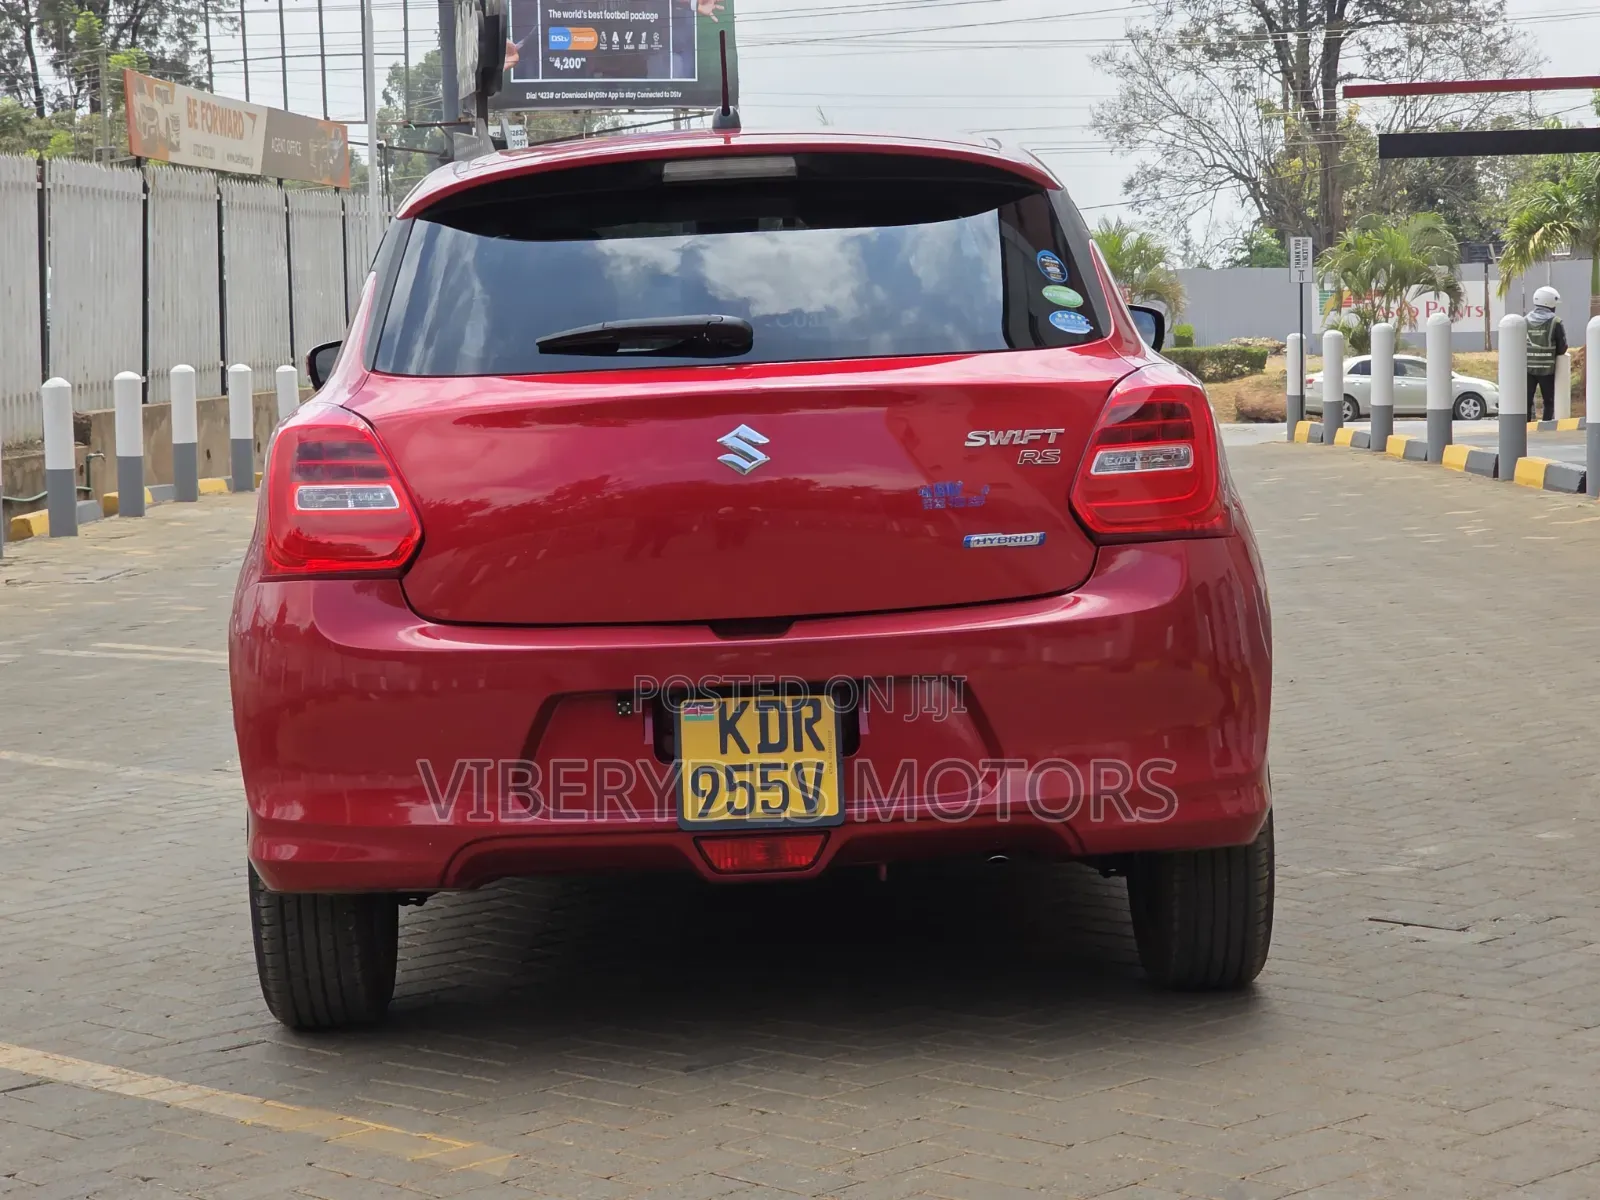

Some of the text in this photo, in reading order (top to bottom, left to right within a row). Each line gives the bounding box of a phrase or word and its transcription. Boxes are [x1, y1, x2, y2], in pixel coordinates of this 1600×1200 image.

[548, 9, 659, 22] The world's best football package
[561, 91, 588, 99] Download
[637, 90, 664, 98] Connected
[186, 96, 245, 141] BE FORWARD
[964, 428, 1065, 447] SWIFT
[1017, 449, 1061, 465] RS
[974, 534, 1035, 545] HYBRID
[718, 696, 826, 756] KDR
[690, 760, 825, 819] 955V
